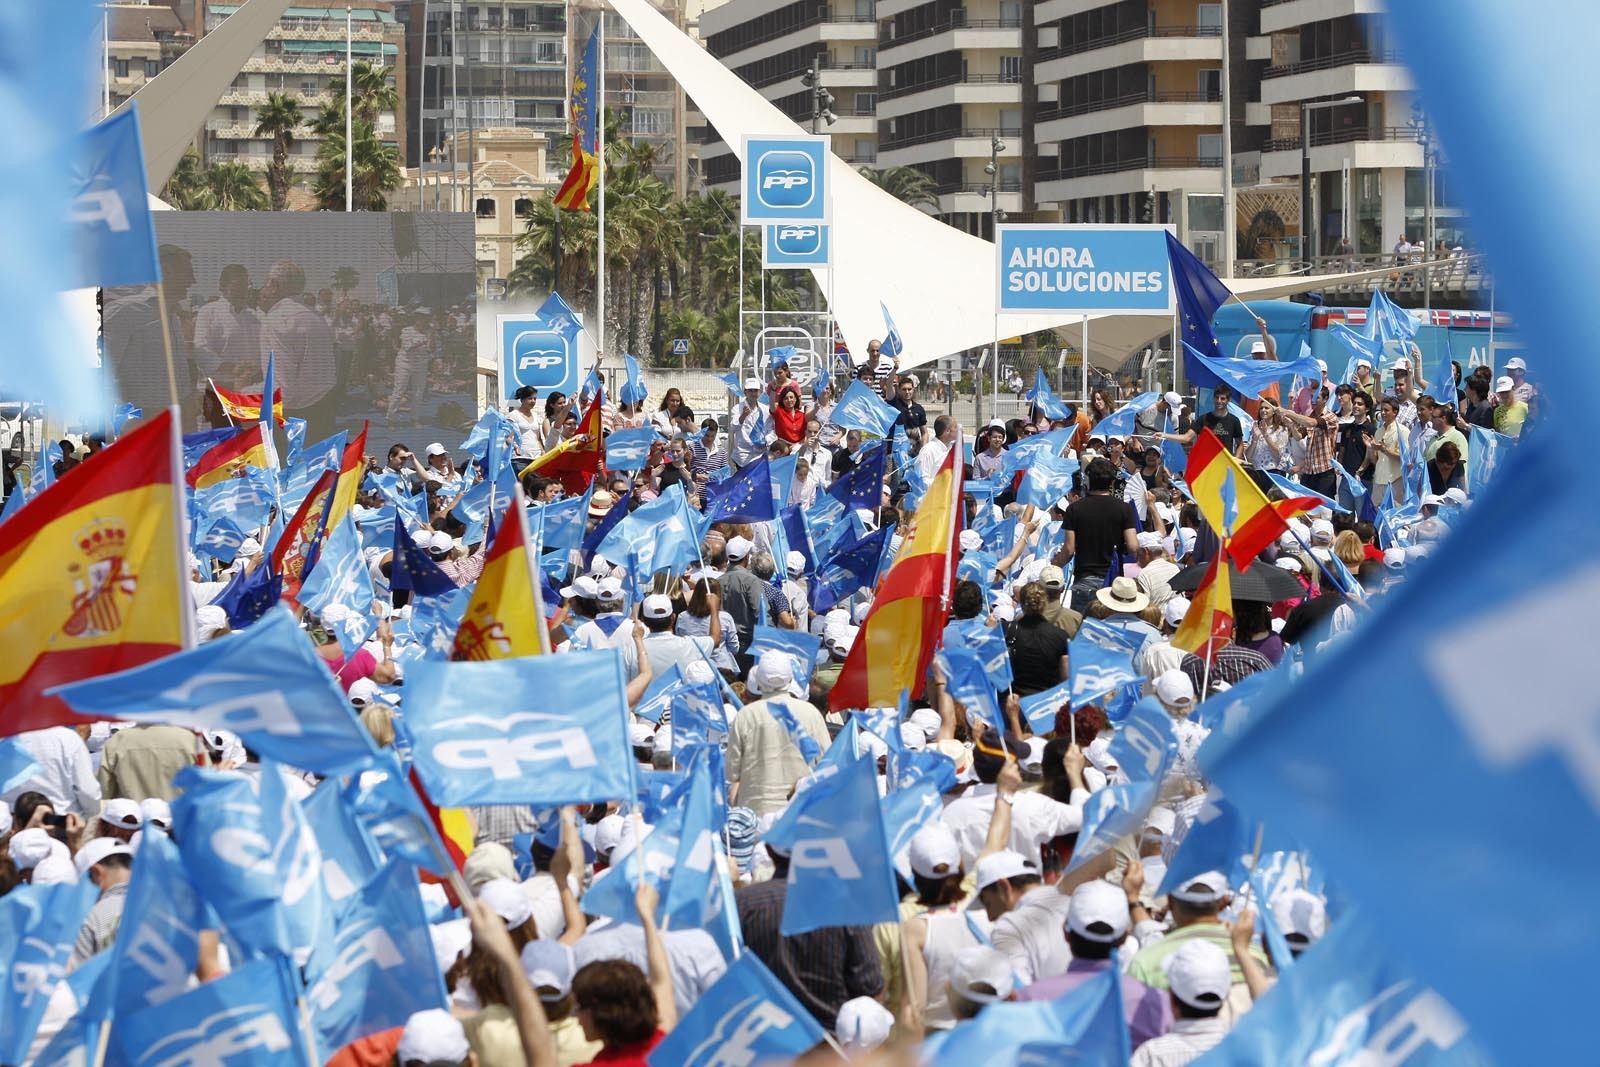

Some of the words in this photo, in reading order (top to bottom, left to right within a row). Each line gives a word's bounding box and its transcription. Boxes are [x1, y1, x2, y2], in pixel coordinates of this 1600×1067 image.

[763, 176, 809, 189] PP
[779, 229, 817, 240] PP
[1008, 247, 1095, 268] AHORA
[1008, 271, 1162, 293] SOLUCIONES
[519, 356, 563, 370] PP
